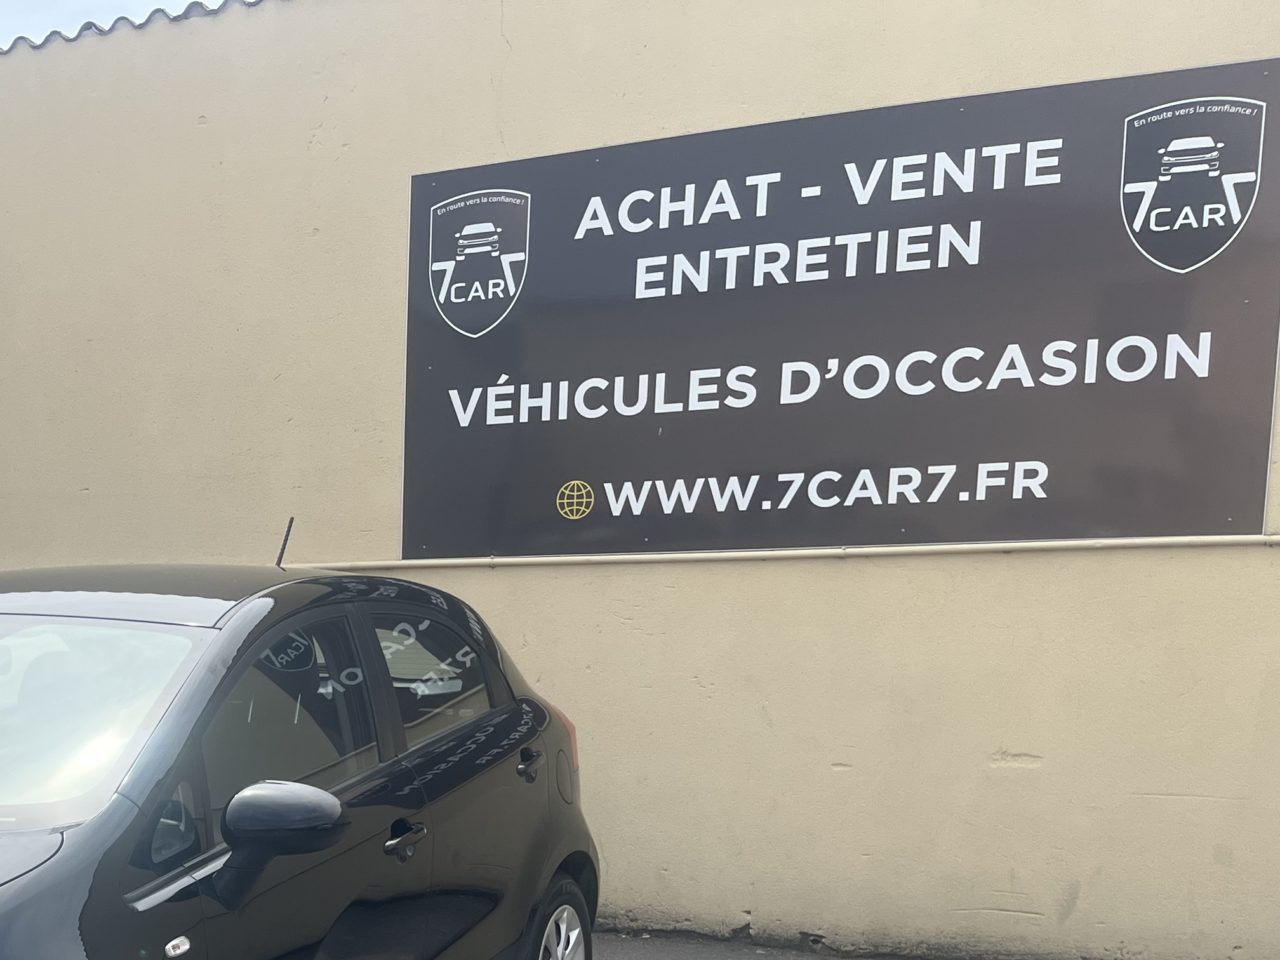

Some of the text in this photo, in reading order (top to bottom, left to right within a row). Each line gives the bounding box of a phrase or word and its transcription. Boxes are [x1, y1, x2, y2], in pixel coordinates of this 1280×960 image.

[1134, 119, 1146, 128] En
[1148, 111, 1173, 123] route
[1175, 107, 1195, 116] vers
[1196, 105, 1205, 113] la
[1207, 104, 1252, 115] confiance
[437, 207, 447, 216] En
[447, 201, 465, 212] route
[466, 196, 481, 206] vers
[481, 195, 489, 203] la
[489, 195, 521, 205] confiance
[573, 172, 782, 240] ACHAT
[844, 138, 1063, 205] VENTE
[635, 220, 982, 300] ENTRETIEN
[448, 365, 757, 427] VÉHICULES
[604, 460, 1049, 517] WWW.7CAR7.FR
